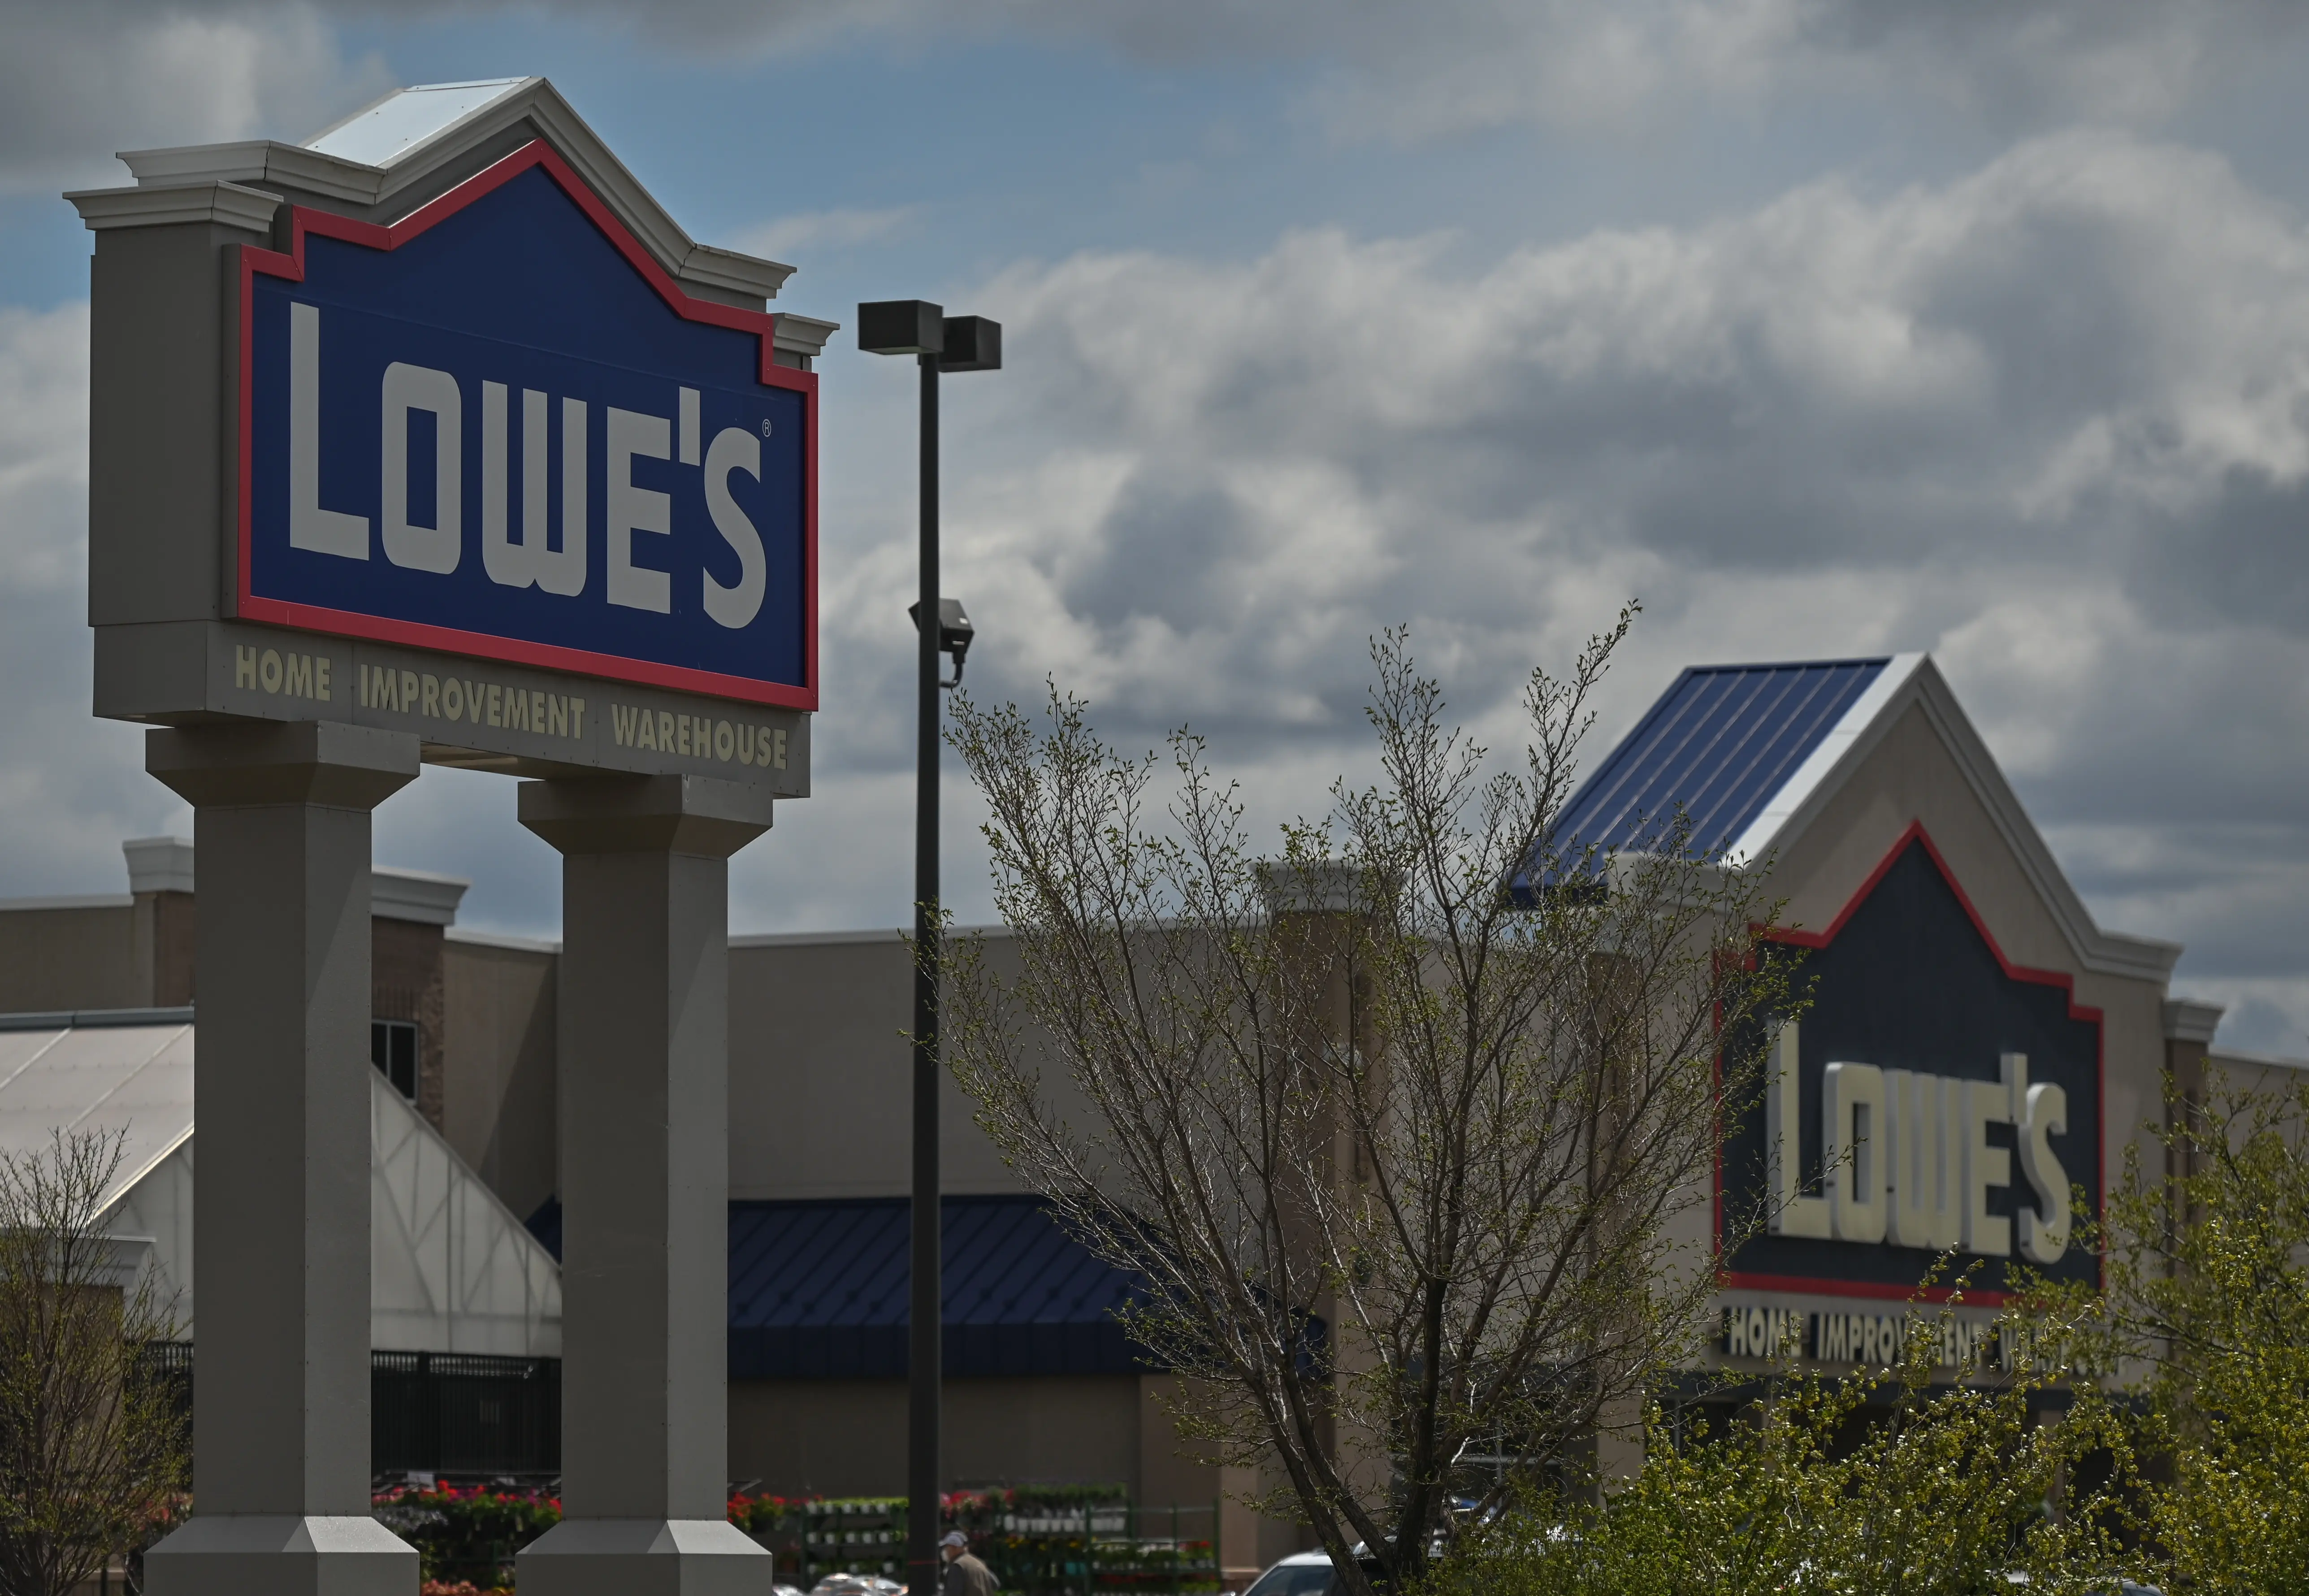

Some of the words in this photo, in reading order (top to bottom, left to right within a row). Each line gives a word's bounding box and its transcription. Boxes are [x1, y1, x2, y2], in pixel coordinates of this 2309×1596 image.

[290, 301, 766, 629] LOWE'S
[236, 645, 331, 701] HOME
[360, 664, 585, 739] IMPROVEMENT
[611, 704, 788, 769] WAREHOUSE
[1766, 1019, 2072, 1264] LOWE'S
[1729, 1306, 1802, 1357] HOME
